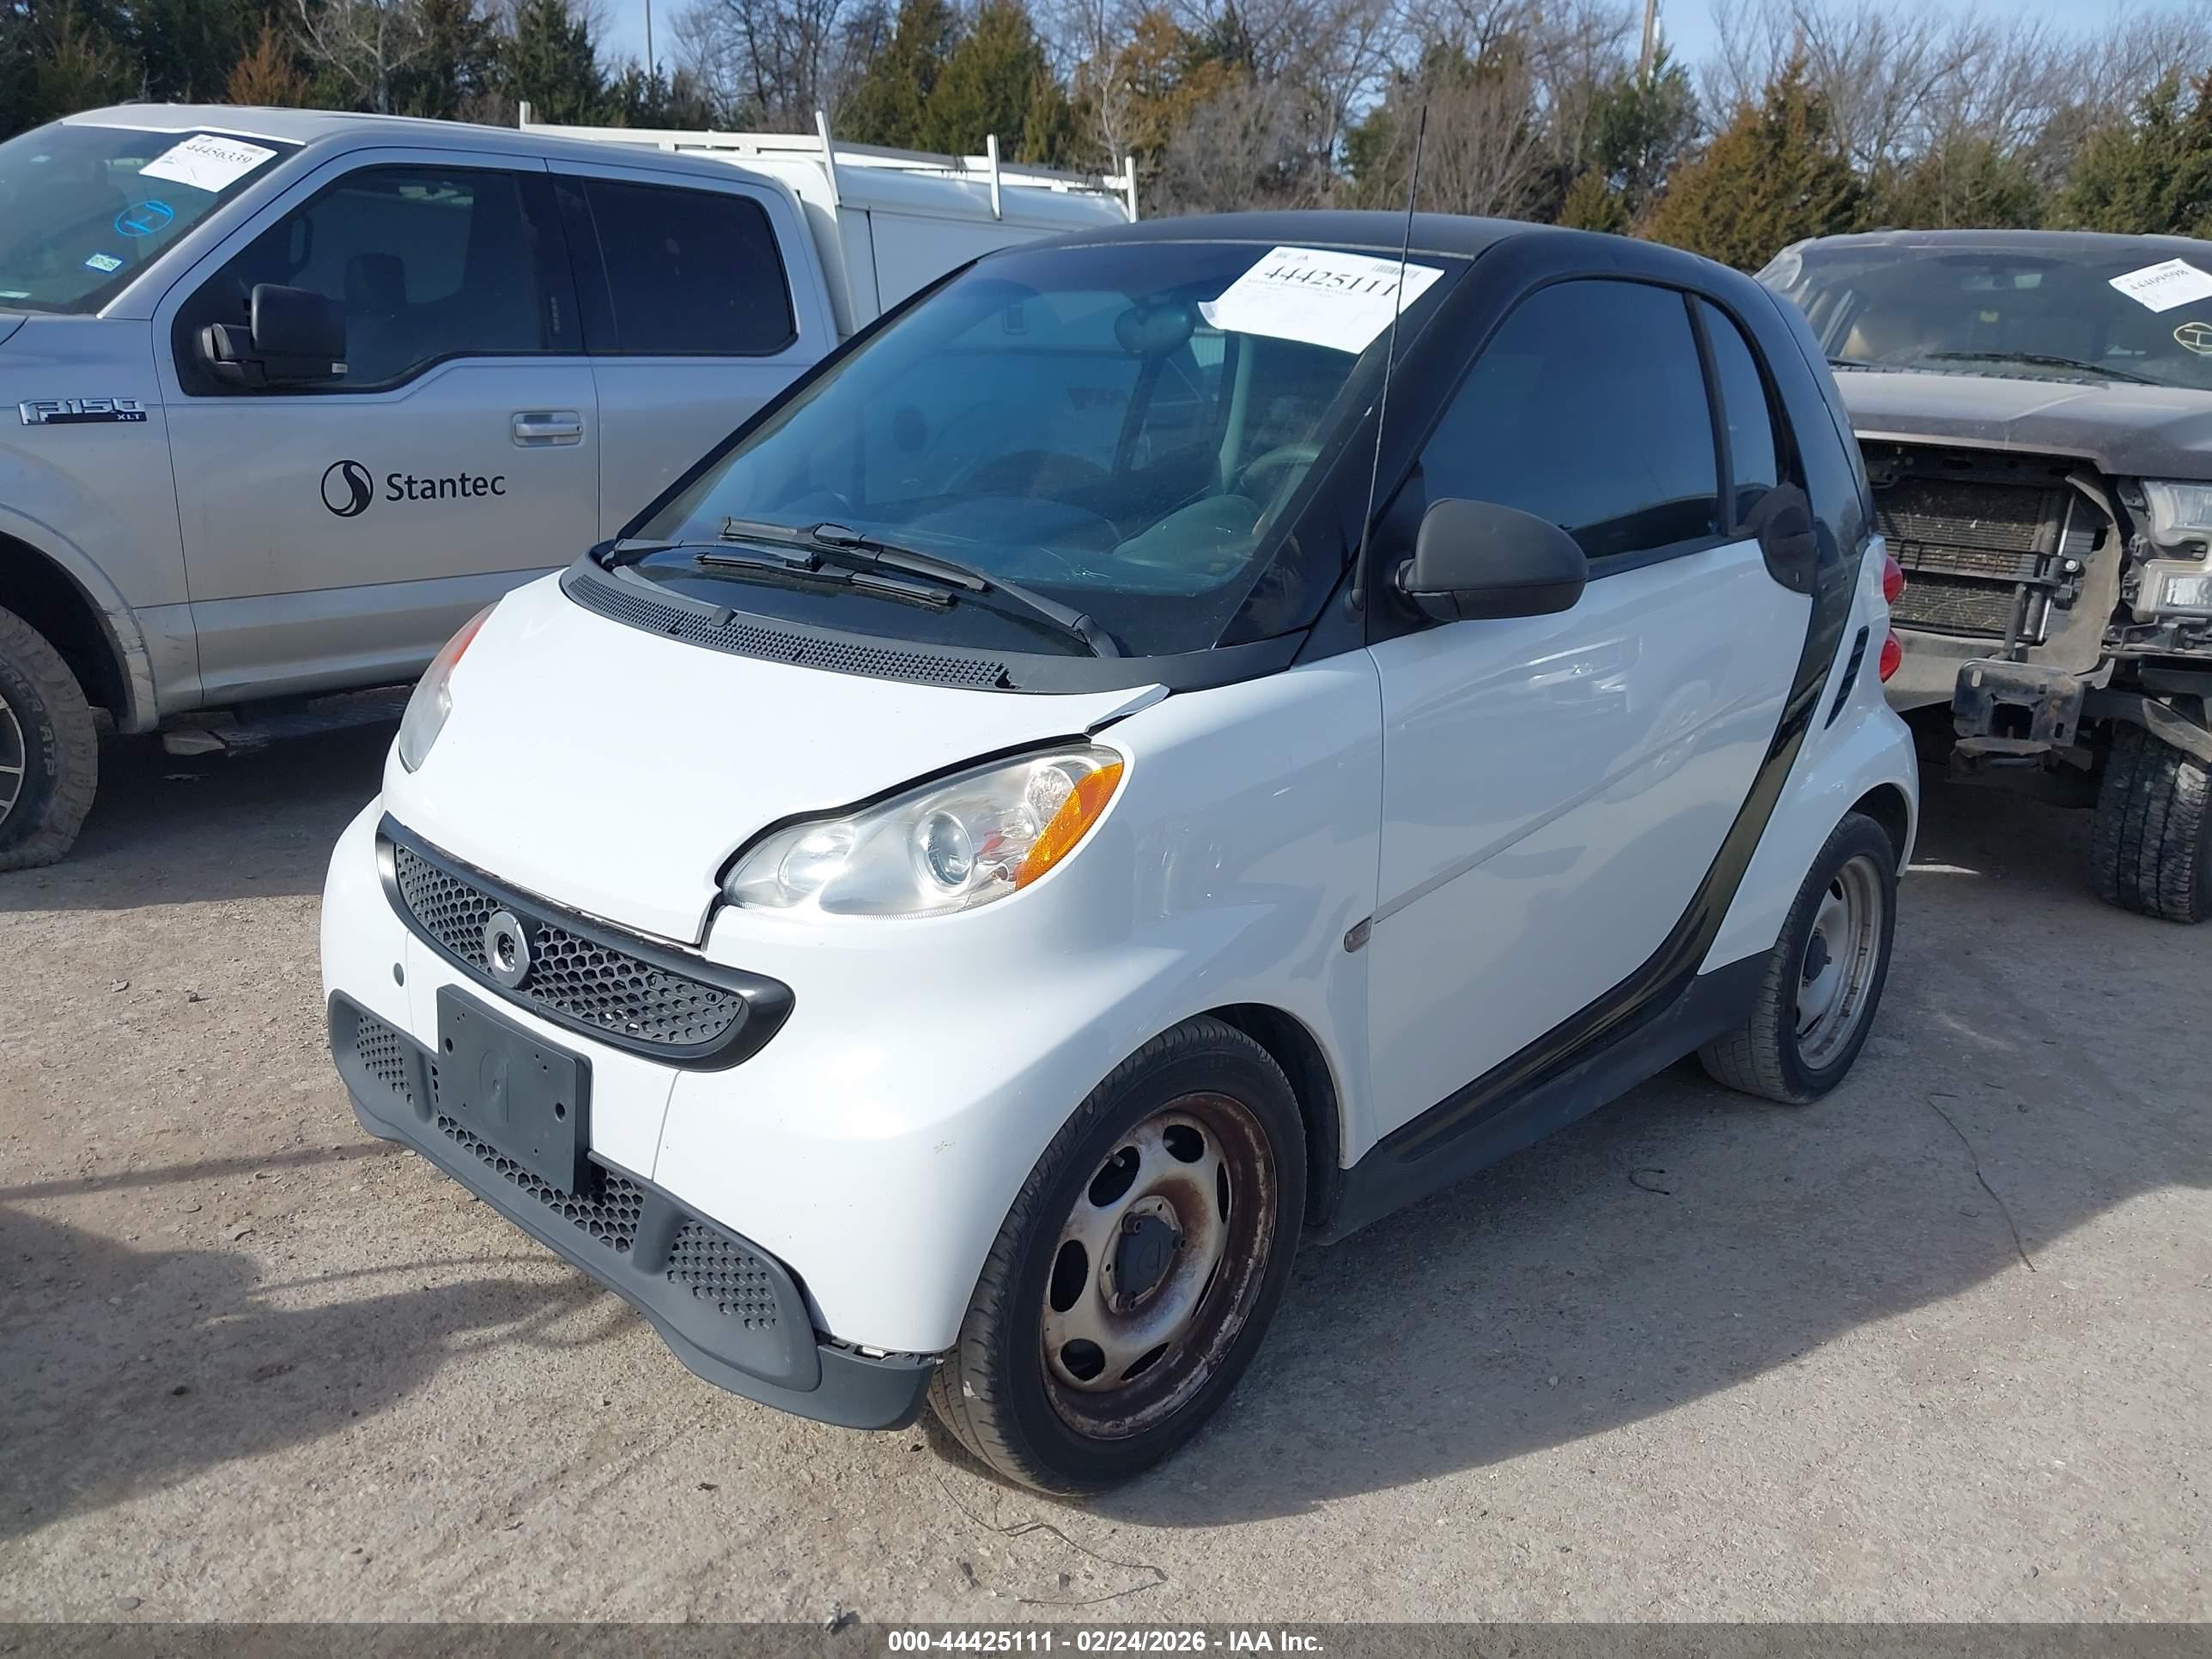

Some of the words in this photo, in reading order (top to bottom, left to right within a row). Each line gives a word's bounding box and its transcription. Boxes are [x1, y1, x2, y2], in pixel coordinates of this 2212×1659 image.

[1264, 264, 1400, 296] 44425111
[116, 412, 142, 421] XLT
[386, 472, 507, 501] Stantec
